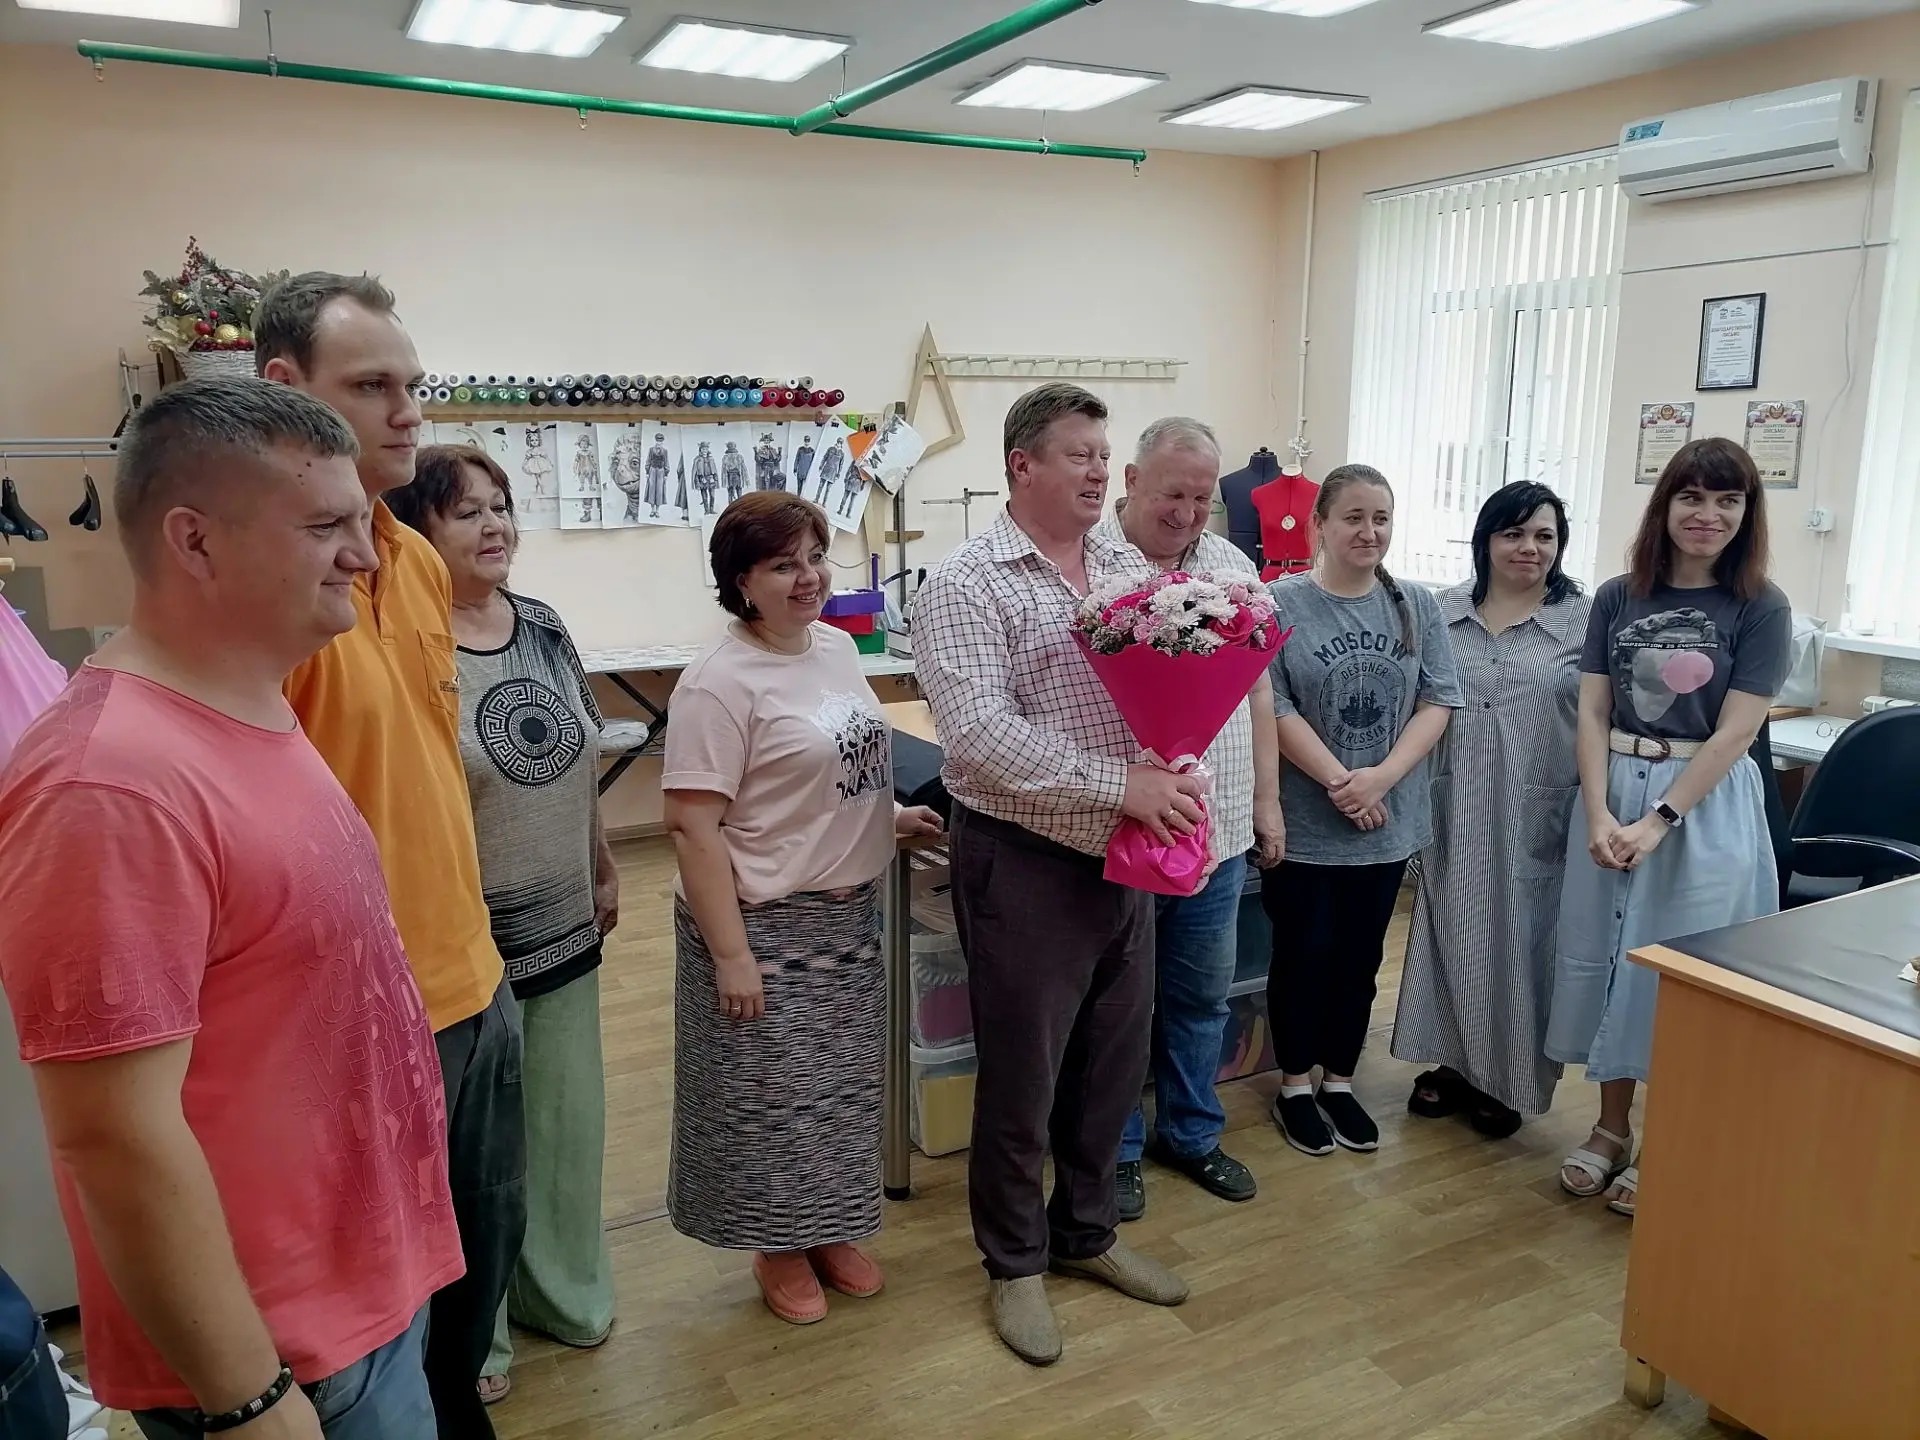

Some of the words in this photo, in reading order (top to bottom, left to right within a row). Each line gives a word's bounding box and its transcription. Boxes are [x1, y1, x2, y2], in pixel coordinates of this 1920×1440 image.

[1313, 630, 1408, 667] MOSCOW
[1341, 661, 1389, 680] DESGNER
[1333, 724, 1346, 738] IN
[1345, 724, 1387, 744] RUSSIA
